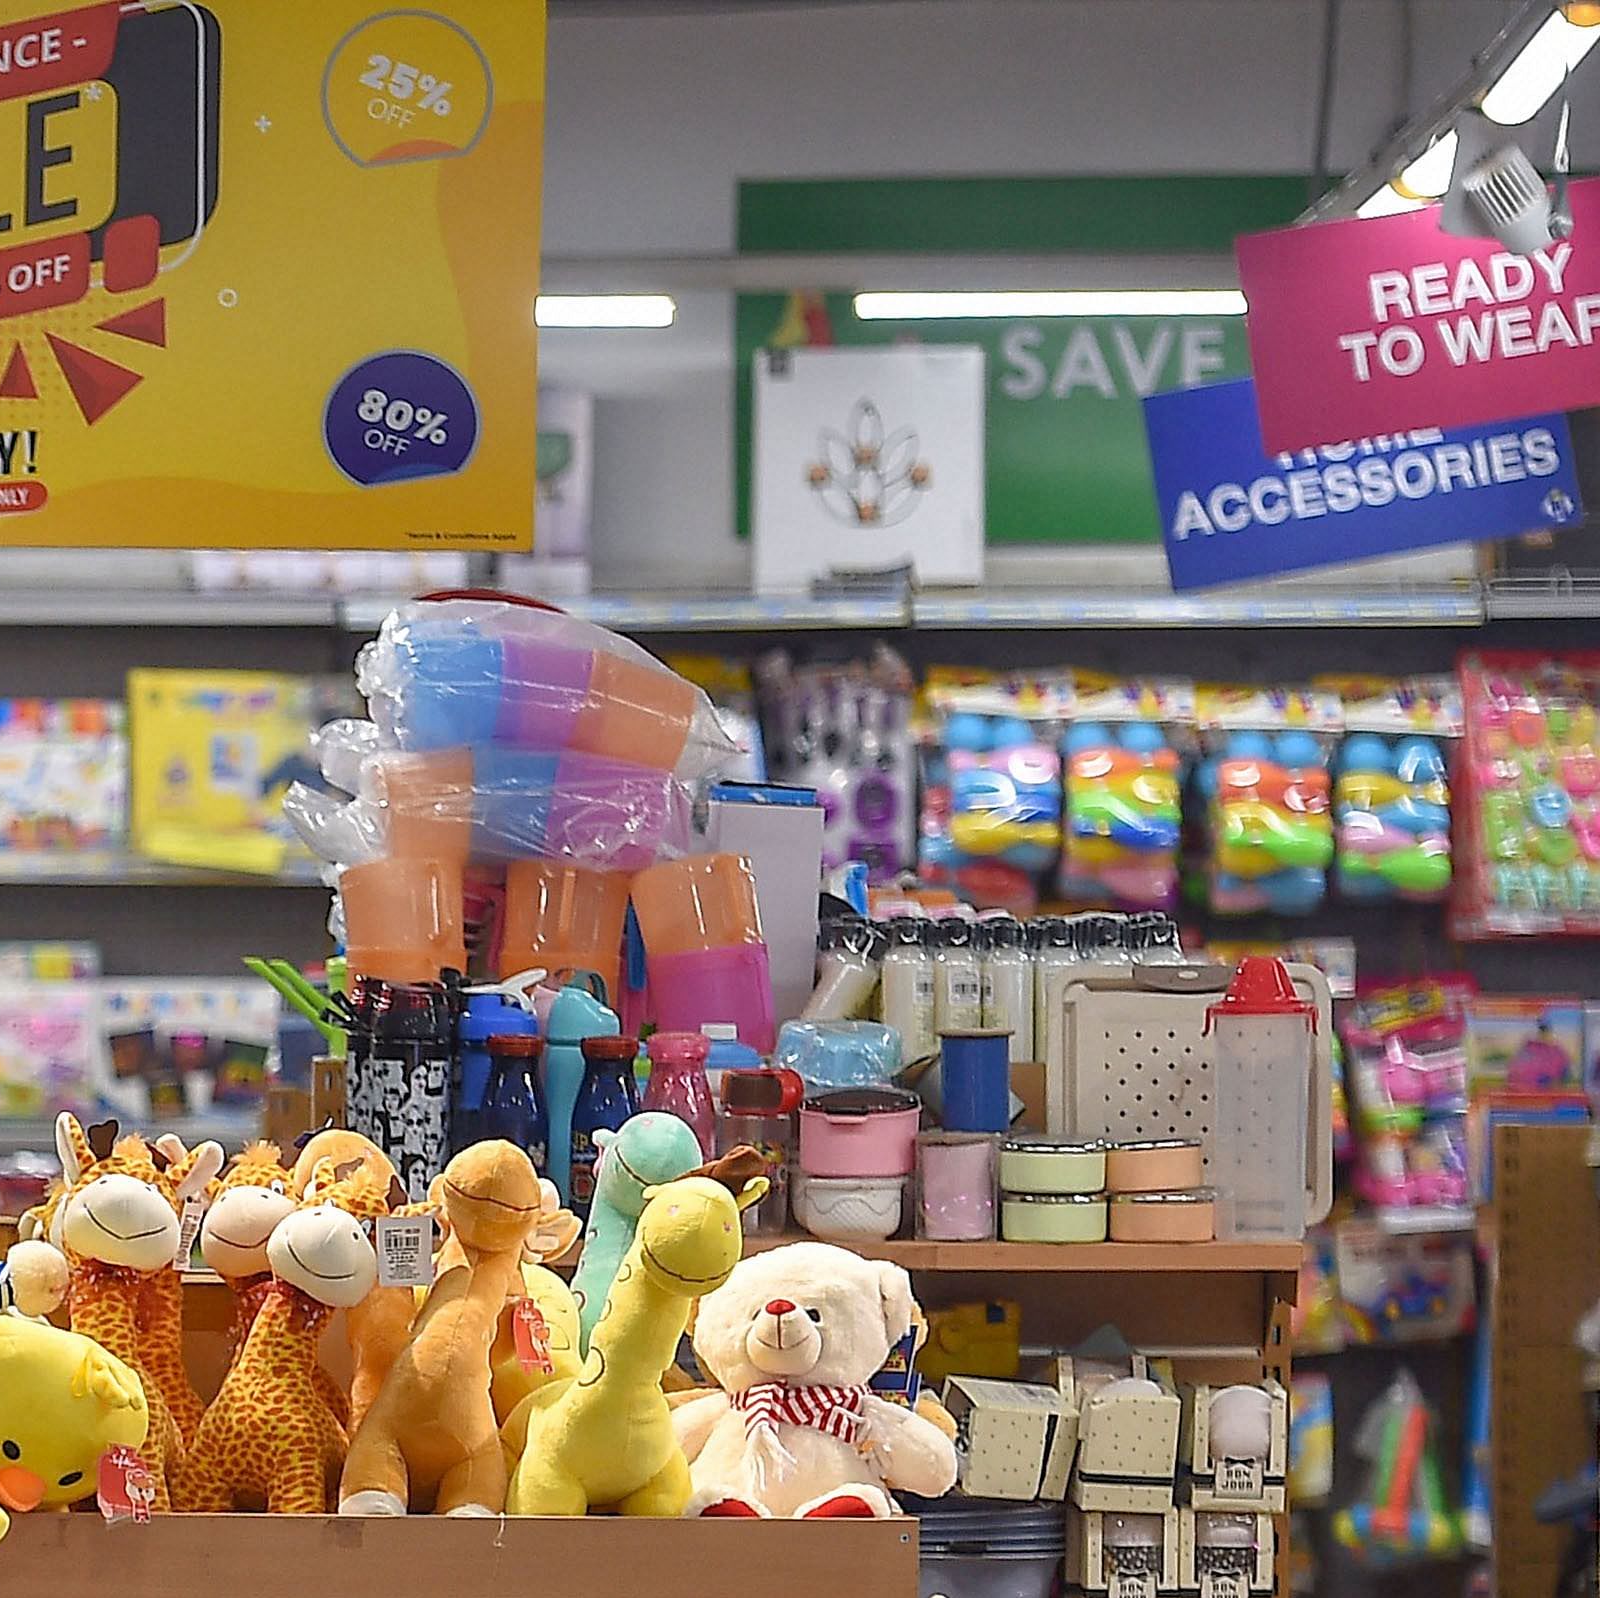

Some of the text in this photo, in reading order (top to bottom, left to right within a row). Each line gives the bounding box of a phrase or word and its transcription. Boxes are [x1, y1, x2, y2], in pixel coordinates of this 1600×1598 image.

[358, 54, 453, 117] 25%
[367, 98, 416, 128] OFF
[7, 254, 72, 293] OFF
[1368, 242, 1574, 323] READY
[1002, 321, 1225, 400] SAVE
[1339, 325, 1426, 384] TO
[357, 388, 449, 445] 80%
[363, 428, 412, 456] OFF
[1172, 427, 1561, 542] ACCESSORIES
